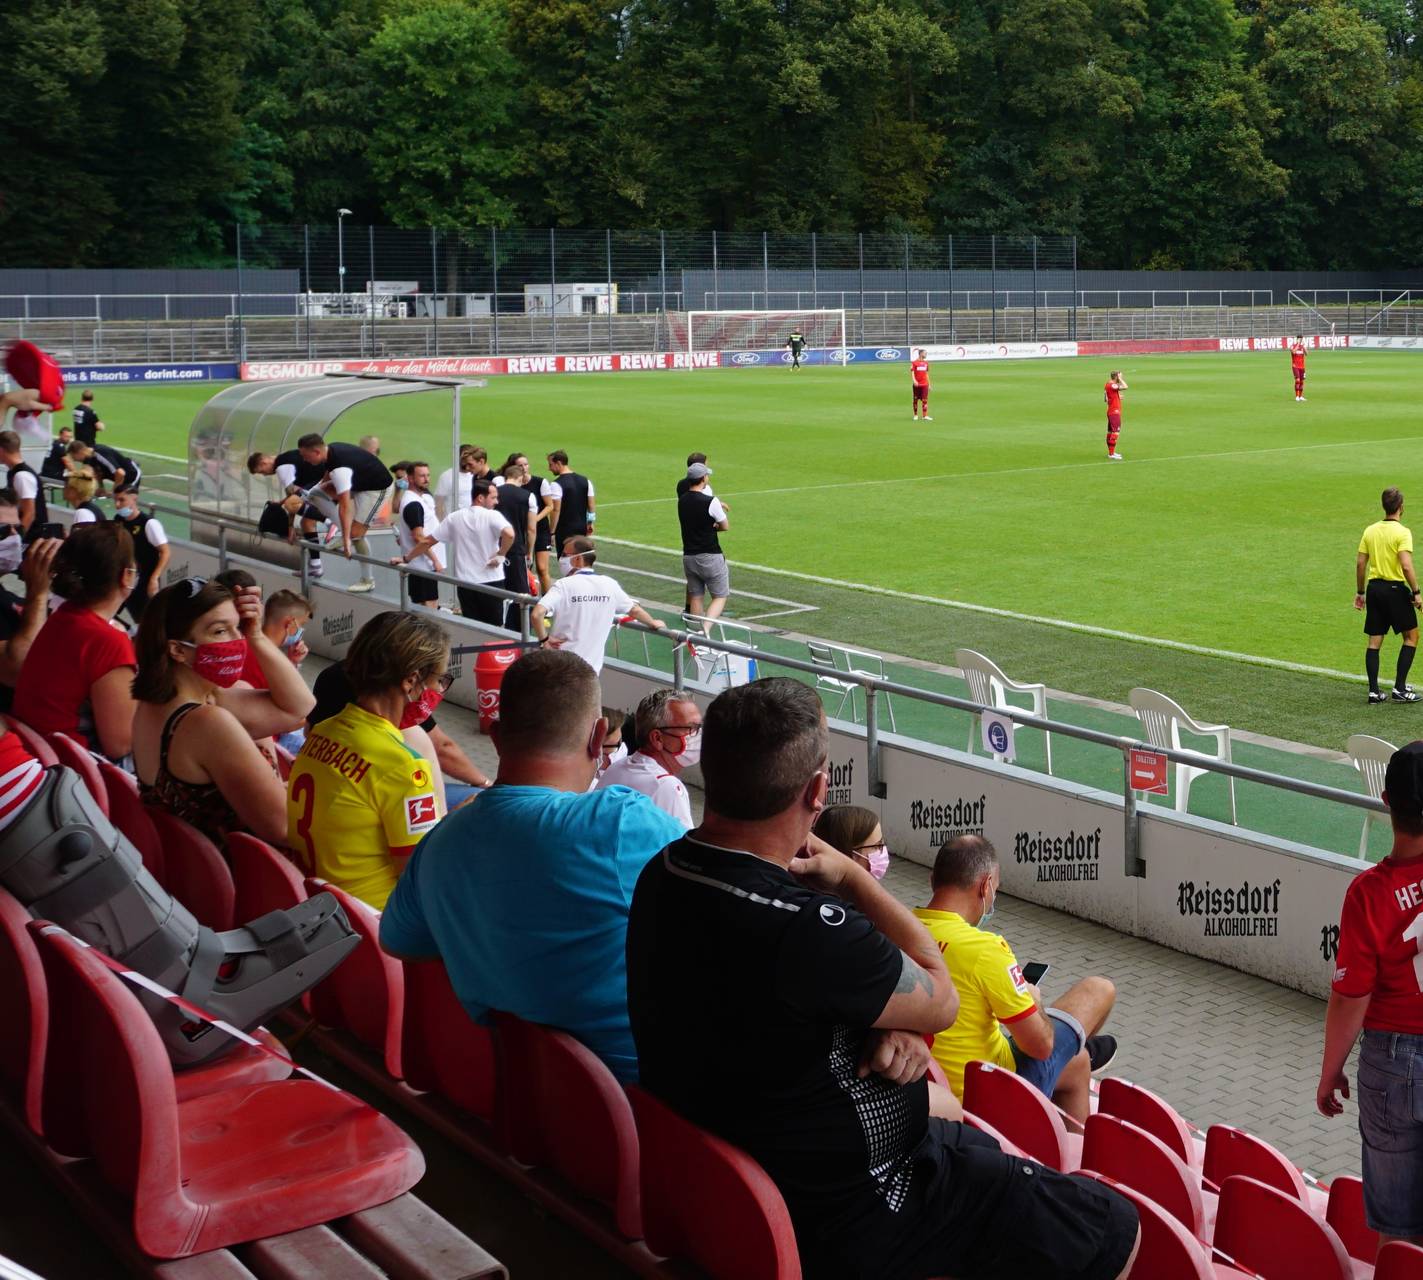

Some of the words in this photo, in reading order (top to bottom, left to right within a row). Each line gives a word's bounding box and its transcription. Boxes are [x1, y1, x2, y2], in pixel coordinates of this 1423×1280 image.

[1220, 338, 1249, 350] REWE
[1254, 337, 1282, 349] REWE
[1319, 336, 1346, 347] REWE
[426, 359, 458, 373] Möbel
[507, 356, 556, 373] REWE
[564, 355, 613, 372] REWE
[620, 354, 666, 370] REWE
[144, 369, 203, 380] dorint.com
[571, 595, 610, 603] SECURITY
[301, 733, 373, 784] TERBACH
[910, 794, 986, 830] Reissdorf
[1013, 827, 1101, 864] Reissdorf
[1036, 863, 1099, 882] ALKOHOLFREI
[1177, 878, 1281, 916] Reissdorf
[1204, 917, 1278, 937] ALKOHOLFREI
